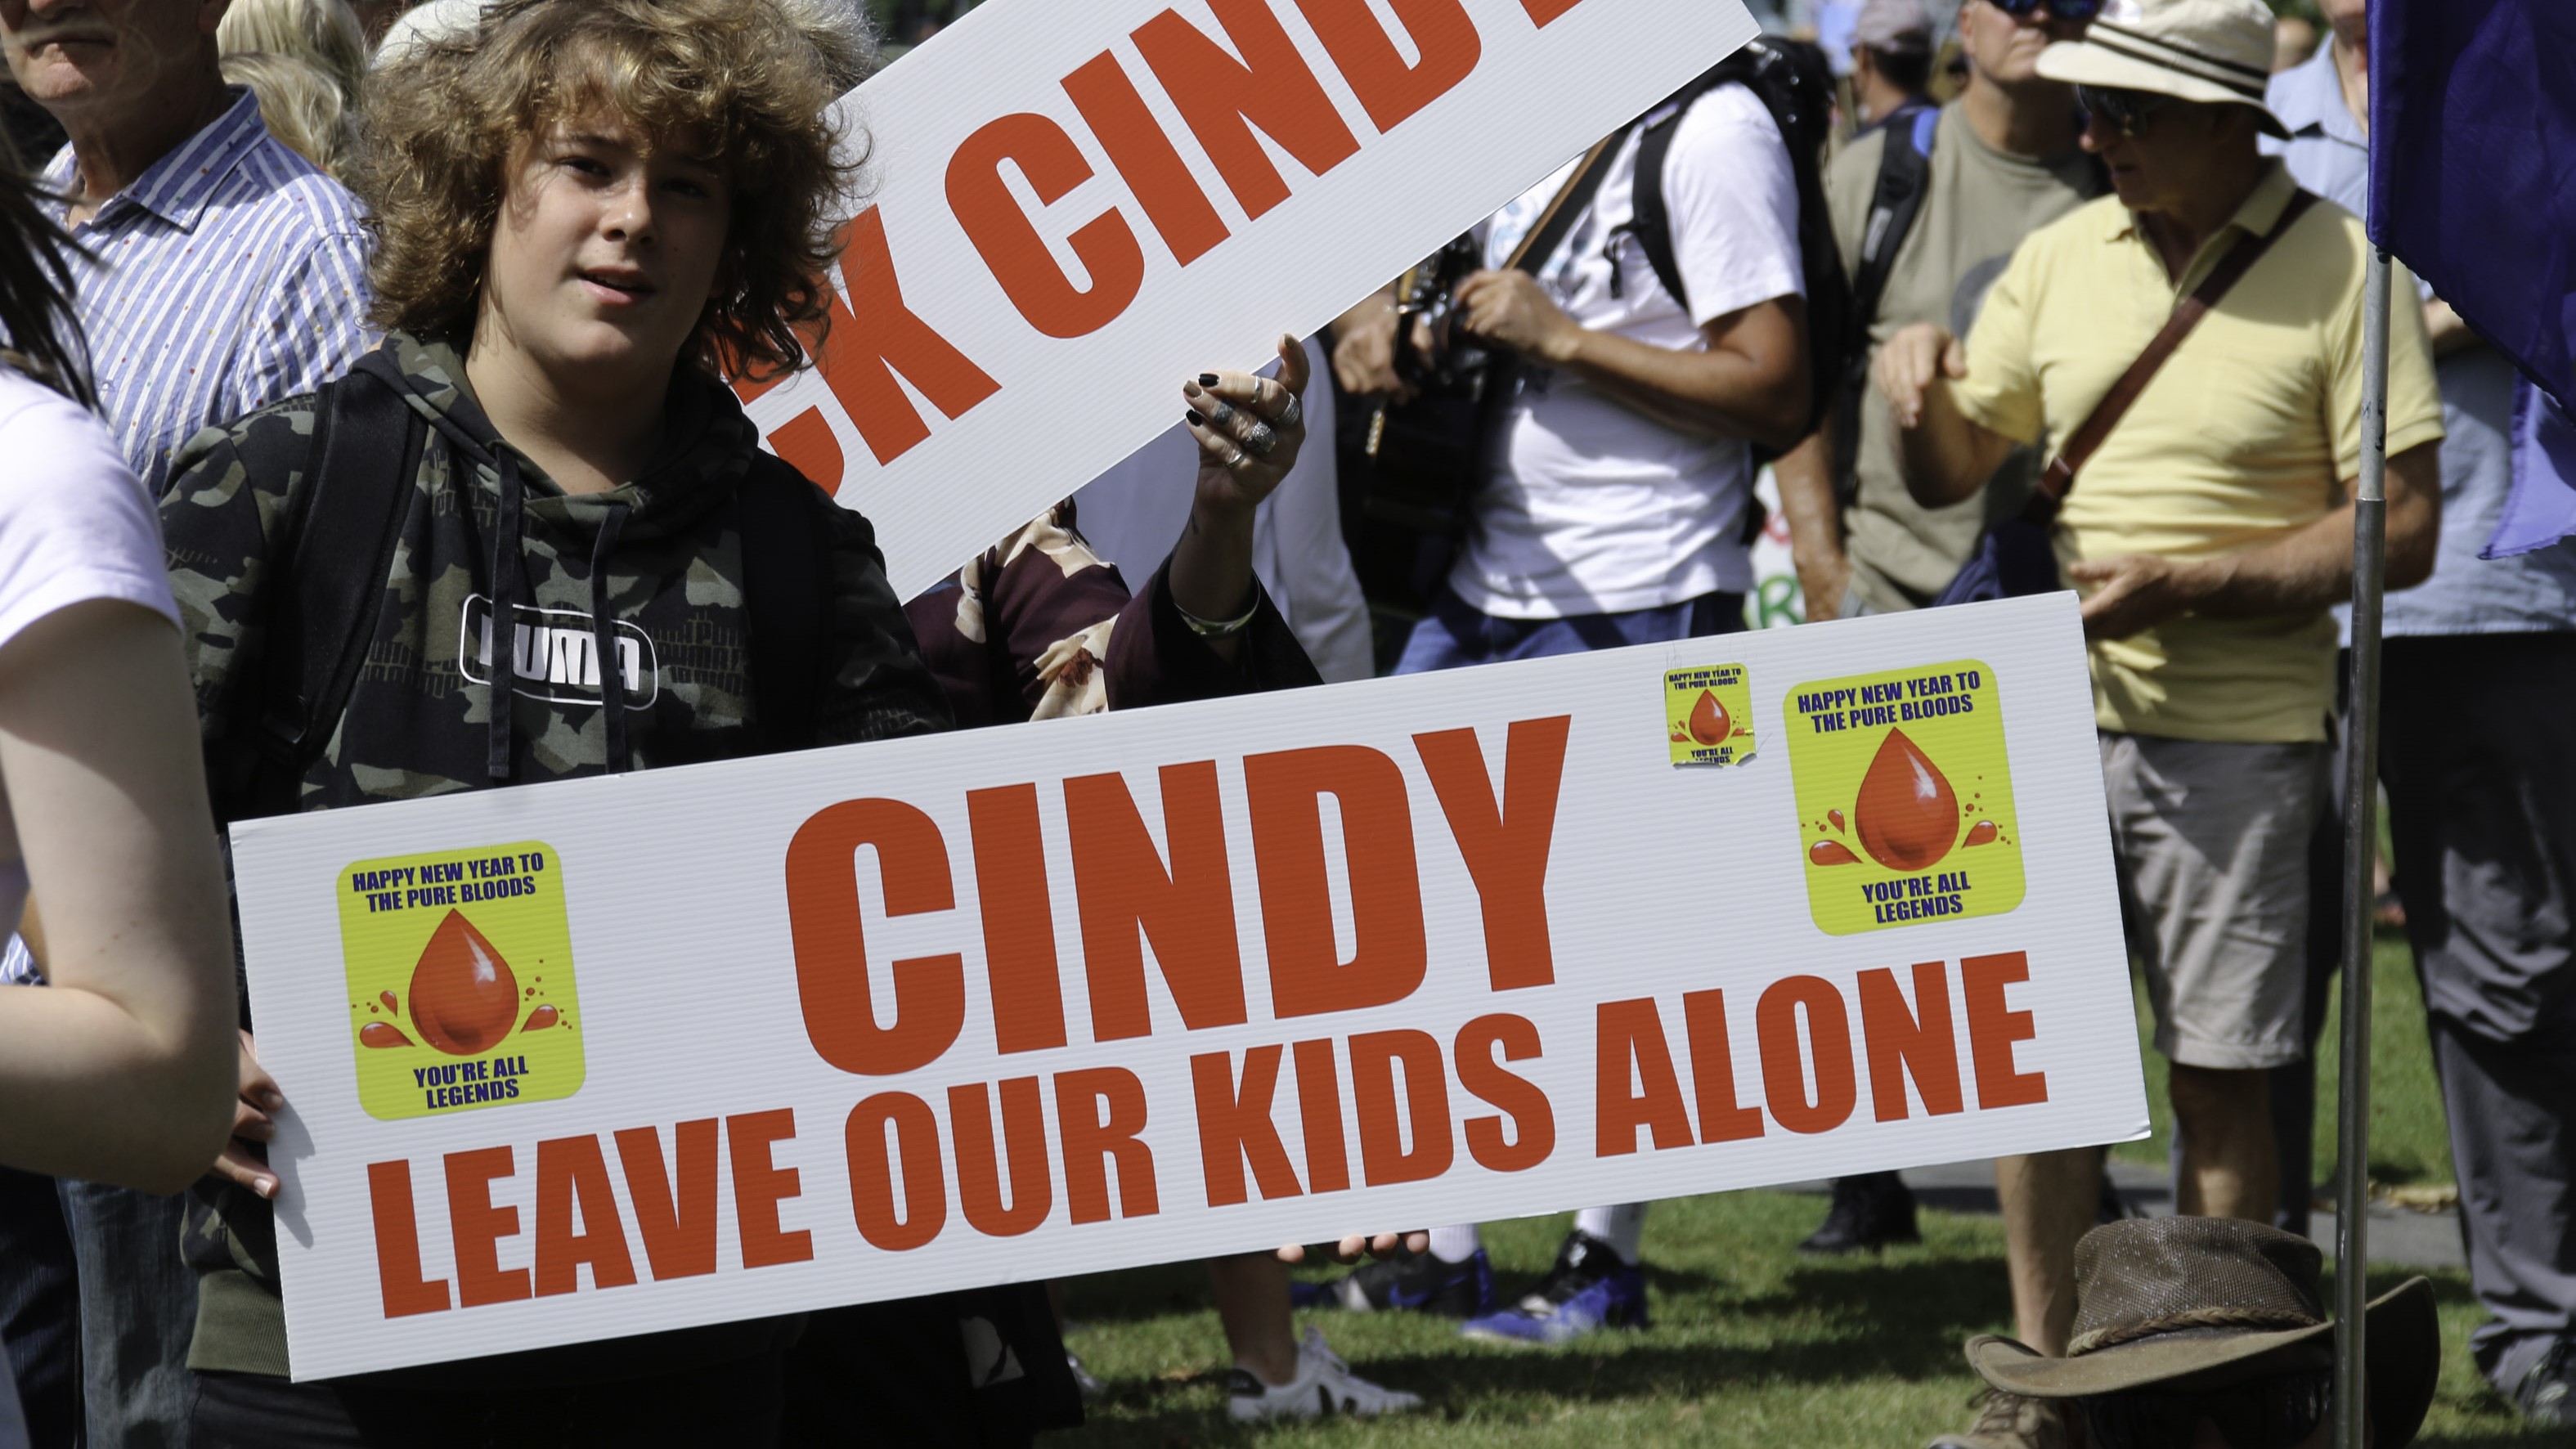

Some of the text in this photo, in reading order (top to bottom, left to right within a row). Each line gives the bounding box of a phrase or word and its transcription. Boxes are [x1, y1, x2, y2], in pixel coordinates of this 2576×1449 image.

[945, 0, 1584, 339] CIND
[1668, 667, 1741, 683] HAPPY NEW YEAR TO
[1674, 676, 1739, 690] THE PURE BLOODS
[1797, 671, 1981, 713] HAPPY NEW YEAR TO
[1811, 693, 1973, 733] THE PURE BLOODS
[1690, 746, 1734, 758] YOU'RE ALL
[352, 852, 544, 891] HAPPY NEW YEAR TO
[1861, 871, 1972, 904] YOU'RE ALL
[366, 876, 536, 913] THE PURE BLOODS
[786, 715, 1572, 1075] CINDY
[1874, 894, 1963, 924] LEGENDS
[413, 1056, 529, 1088] YOU'RE ALL
[426, 1078, 519, 1110] LEGENDS
[368, 951, 2048, 1318] LEAVE OUR KIDS ALONE
